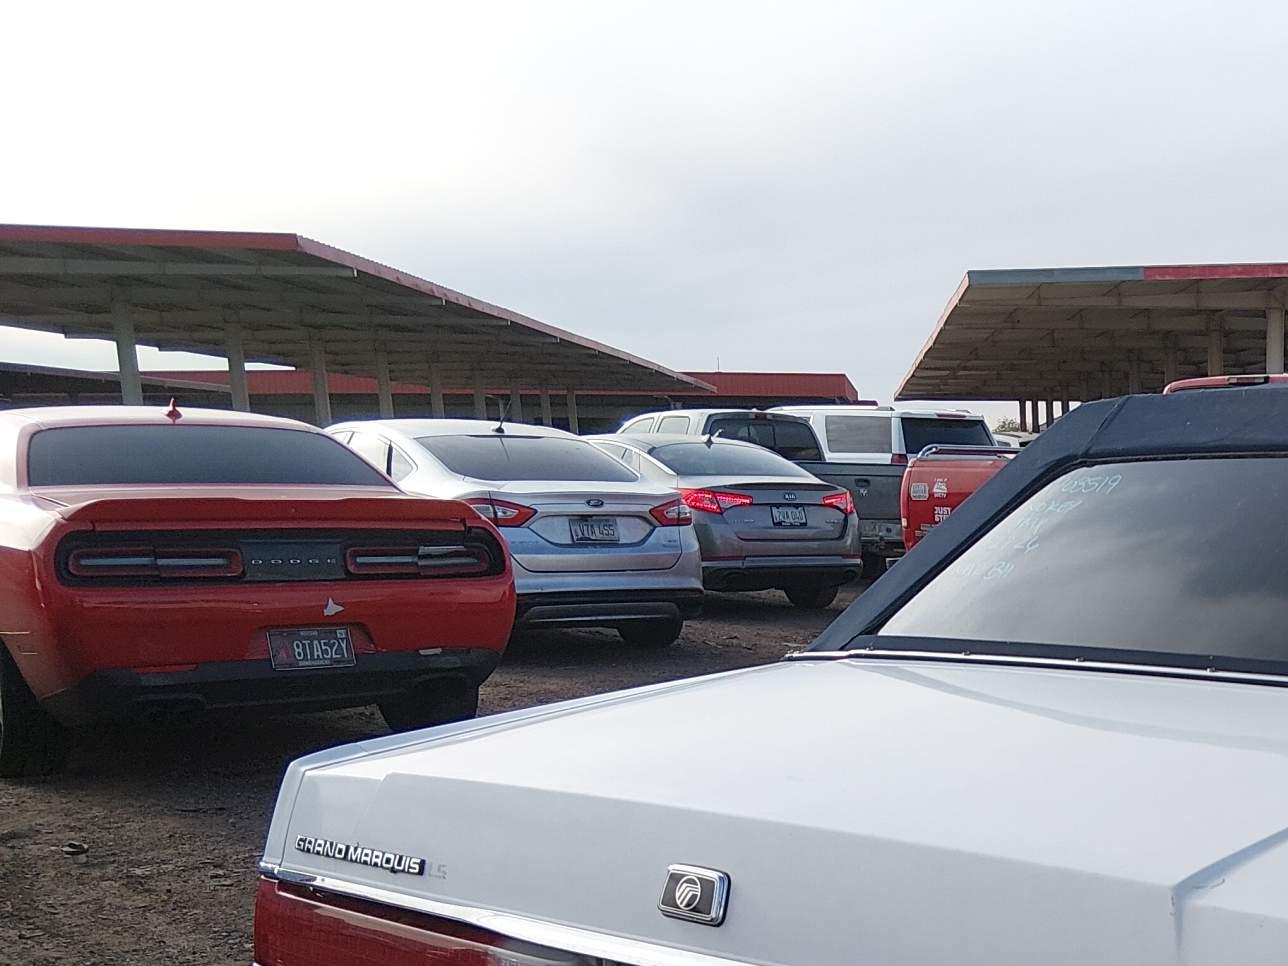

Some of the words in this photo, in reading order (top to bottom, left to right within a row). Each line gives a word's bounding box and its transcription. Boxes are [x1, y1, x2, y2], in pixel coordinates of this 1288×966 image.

[933, 506, 952, 515] JUST
[293, 640, 348, 660] 8TA52Y
[295, 835, 347, 859] GRAND
[348, 845, 422, 875] MARQUIS
